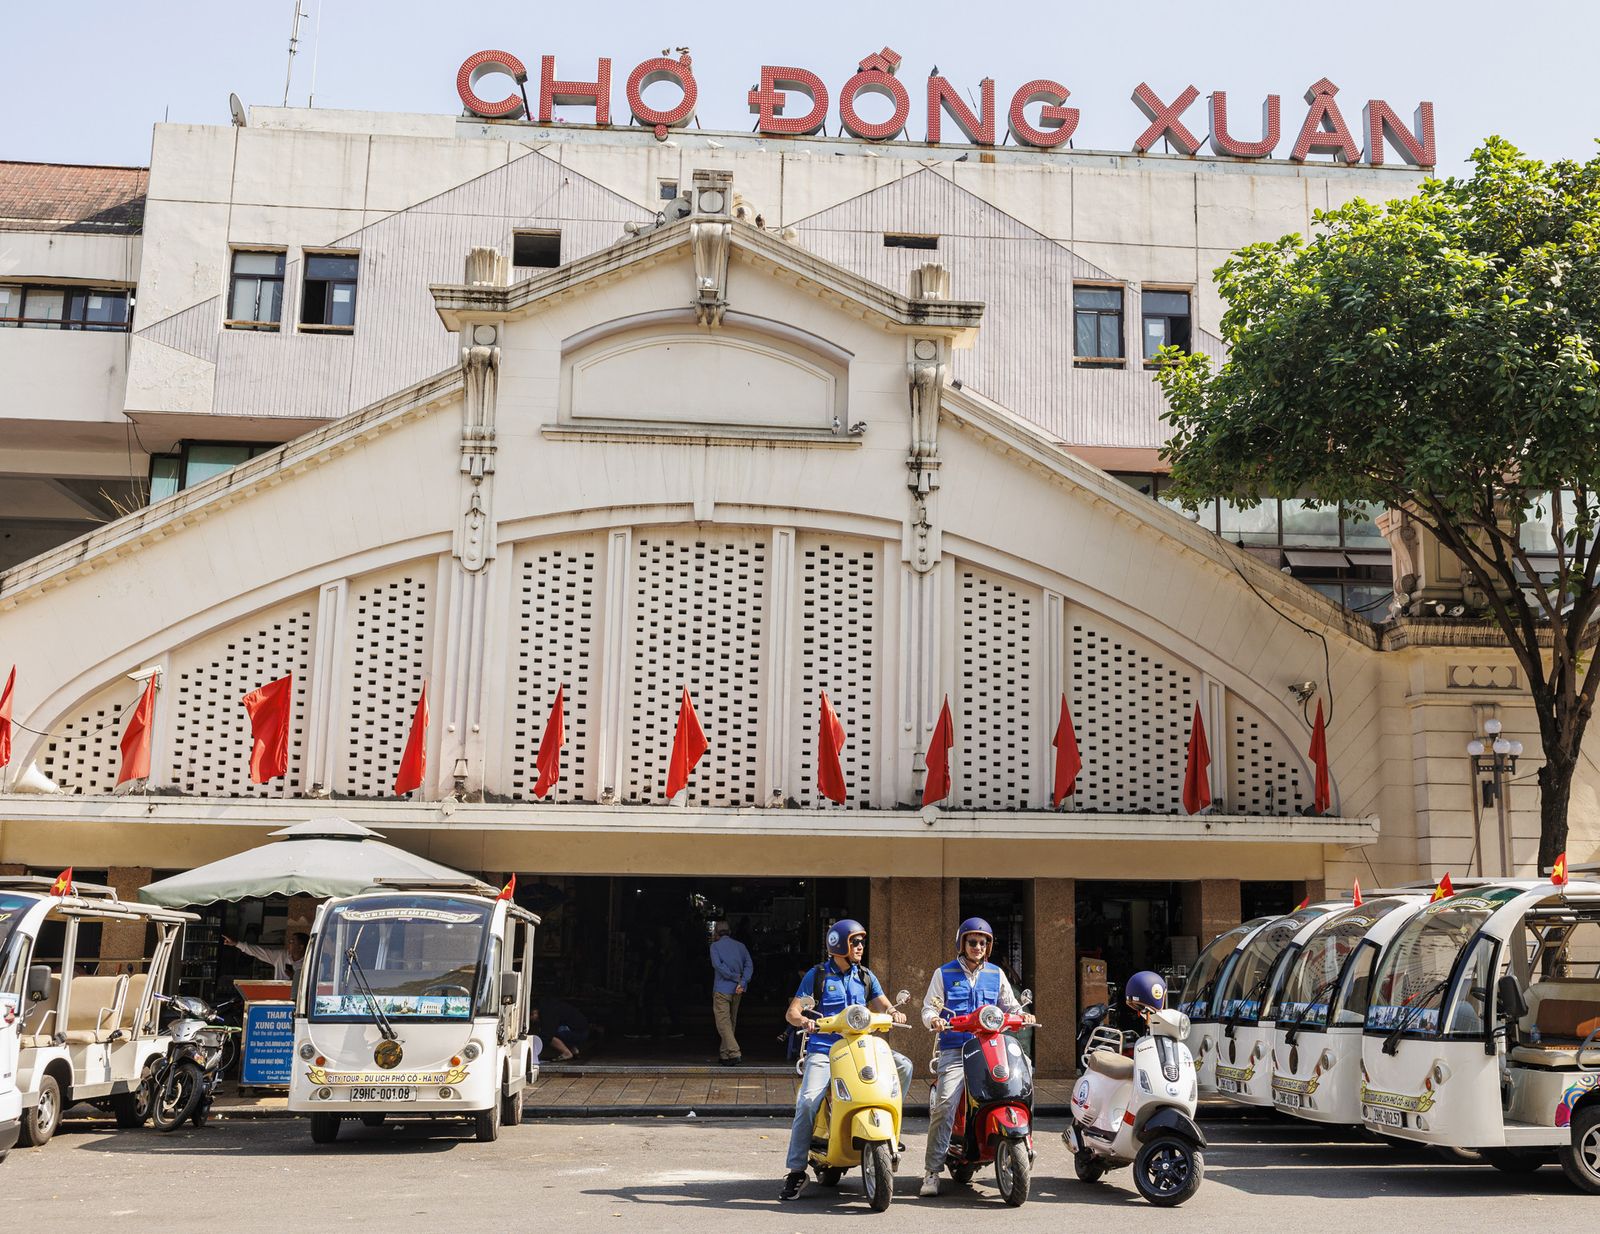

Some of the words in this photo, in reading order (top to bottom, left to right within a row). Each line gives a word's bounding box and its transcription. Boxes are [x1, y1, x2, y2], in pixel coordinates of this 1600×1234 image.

[456, 49, 698, 141] CHỢ
[1131, 77, 1435, 166] XUÂN
[266, 1011, 287, 1020] THAM
[255, 1021, 275, 1030] XUNG
[327, 1075, 342, 1083] CITY
[343, 1075, 360, 1083] TOUR
